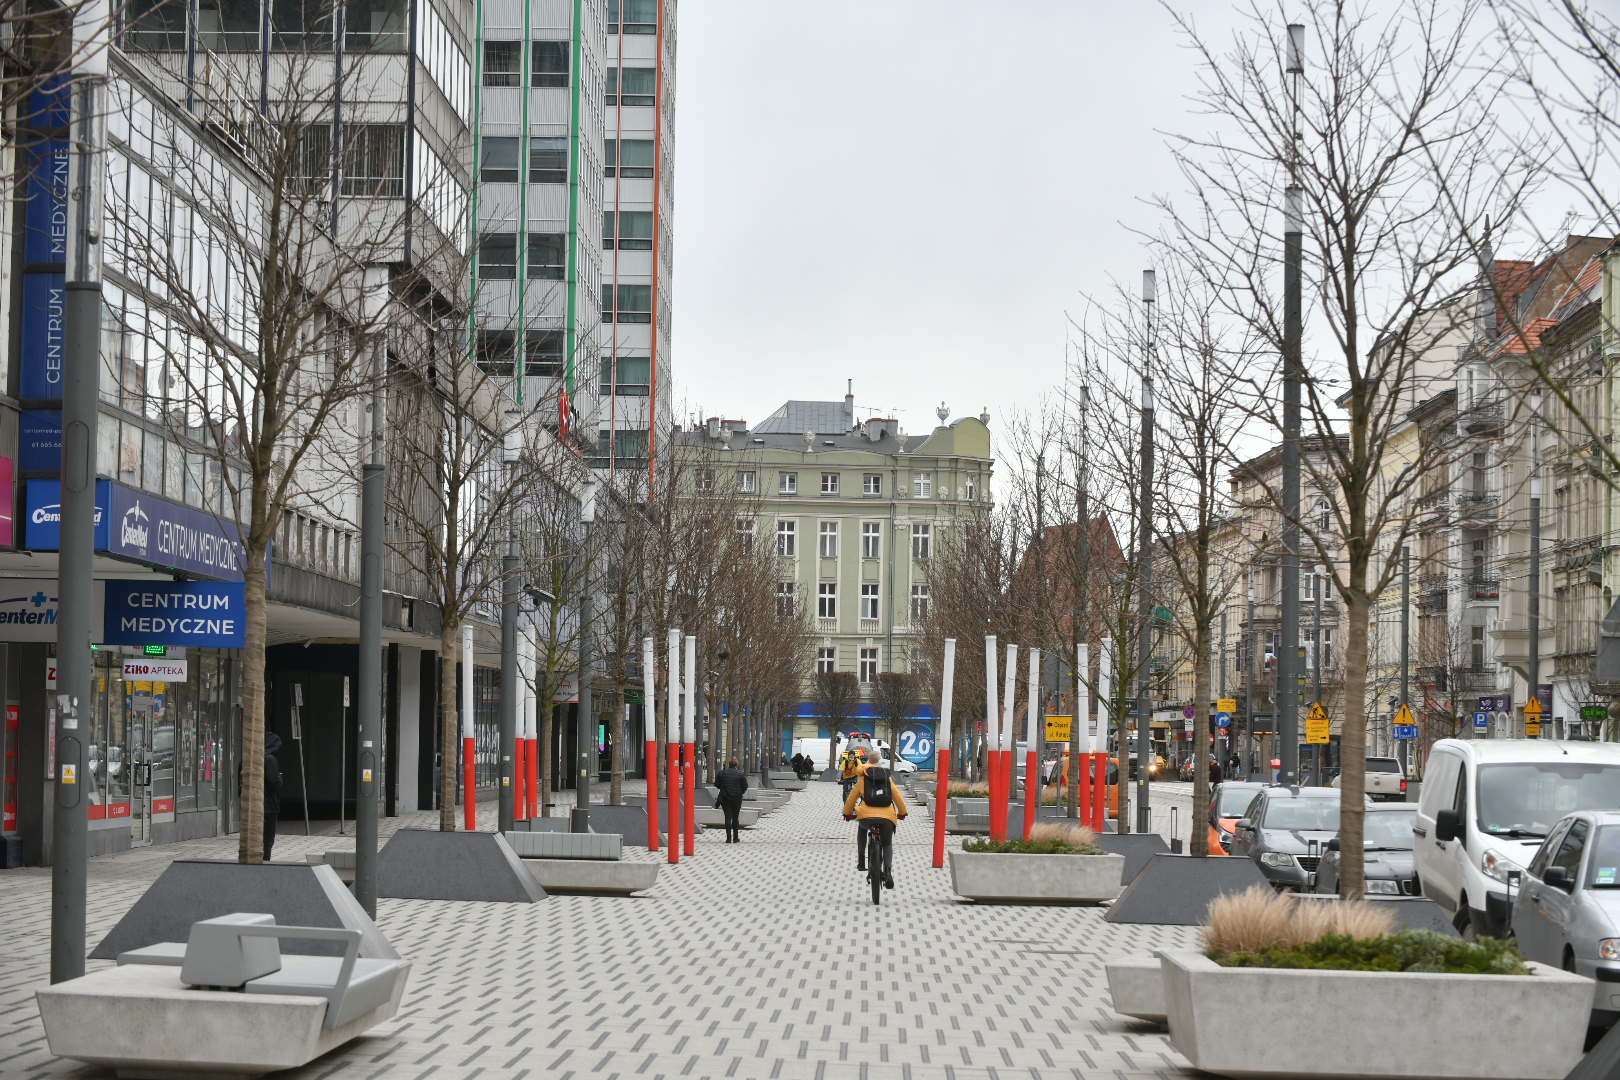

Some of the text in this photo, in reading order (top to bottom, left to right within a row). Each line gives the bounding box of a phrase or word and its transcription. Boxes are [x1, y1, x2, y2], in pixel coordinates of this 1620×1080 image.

[46, 148, 69, 384] CENTRUM MEDYCZNE
[158, 519, 238, 571] CENTRUM MEDYCZNE
[127, 592, 229, 610] CENTRUM
[0, 608, 58, 625] enterM
[121, 617, 235, 635] MEDYCZNE
[150, 666, 184, 675] APTEKA
